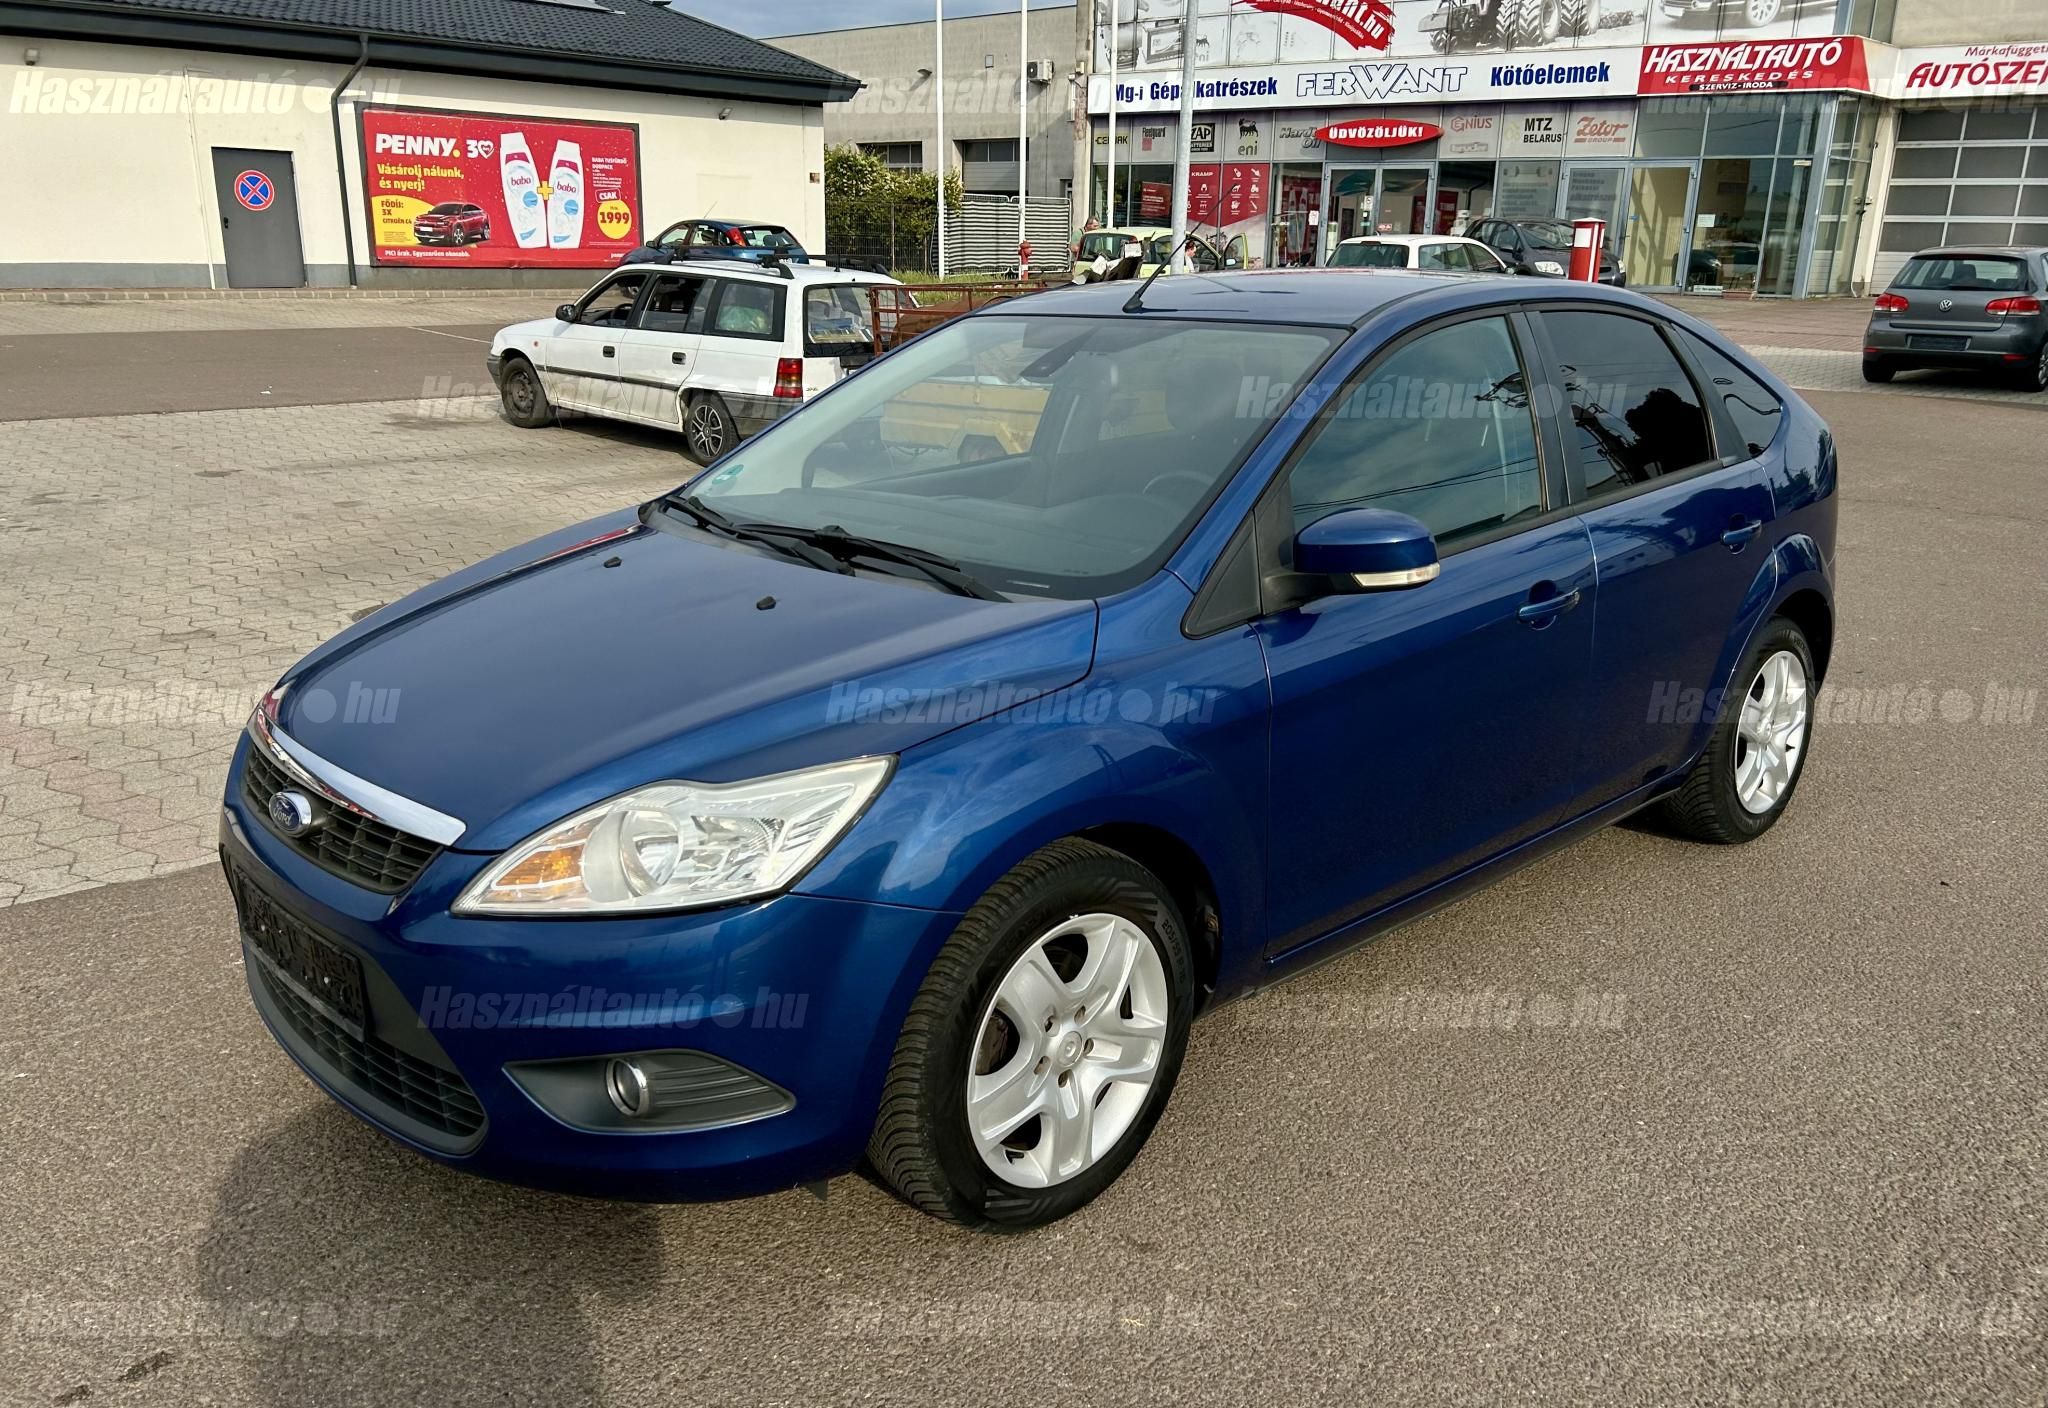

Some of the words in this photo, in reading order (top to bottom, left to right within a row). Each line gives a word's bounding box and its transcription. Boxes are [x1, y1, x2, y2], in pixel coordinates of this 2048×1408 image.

[1644, 37, 1842, 74] HASZNÁLTAUTÓ
[1490, 61, 1611, 86] Kötőelemek
[1664, 70, 1814, 84] KERESKEDÉS
[1150, 77, 1278, 101] Gépkatrészek
[1524, 118, 1552, 131] MTZ
[1577, 116, 1629, 137] Zetor
[1329, 125, 1424, 140] ÜDVÖZÖLJÜK!
[1523, 133, 1562, 143] BELARUS
[1237, 141, 1258, 155] eni
[377, 163, 422, 177] Vásárolj
[423, 165, 464, 179] nálunk,
[379, 177, 392, 188] és
[393, 180, 425, 191] nyerj!
[599, 191, 618, 200] CSAK
[600, 212, 630, 224] 1999
